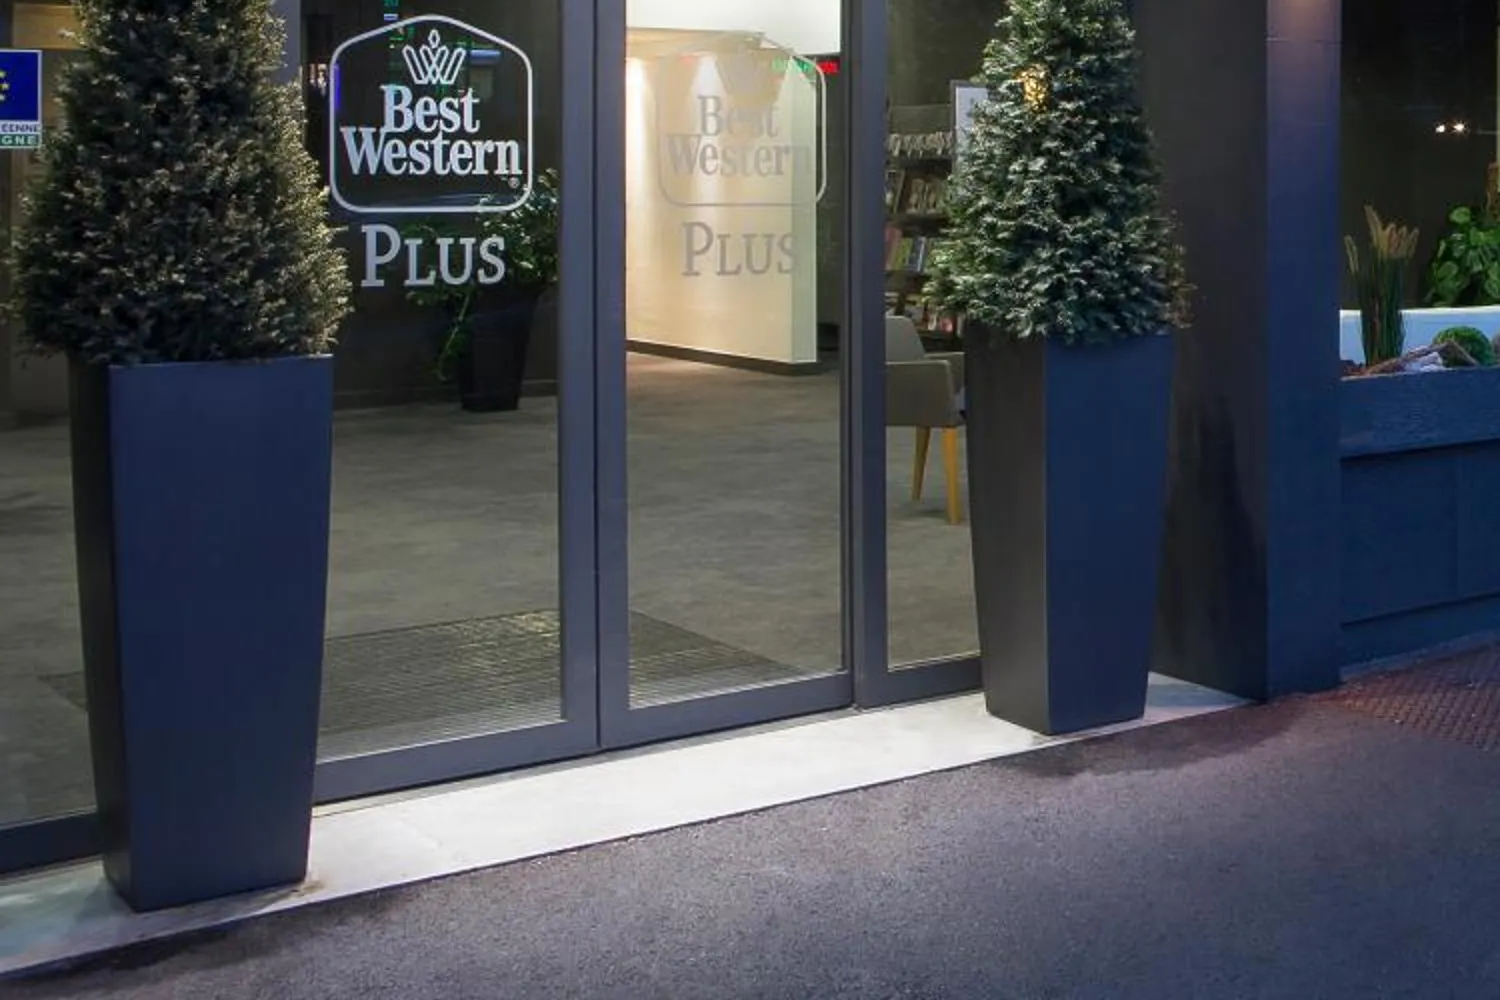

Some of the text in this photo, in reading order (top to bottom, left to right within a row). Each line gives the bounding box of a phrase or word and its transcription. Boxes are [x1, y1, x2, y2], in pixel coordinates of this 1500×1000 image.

[380, 84, 480, 134] Best
[697, 95, 778, 138] Best
[340, 126, 522, 175] Western
[667, 134, 809, 177] Western
[361, 224, 506, 287] PLUS
[681, 221, 801, 277] PLUS
